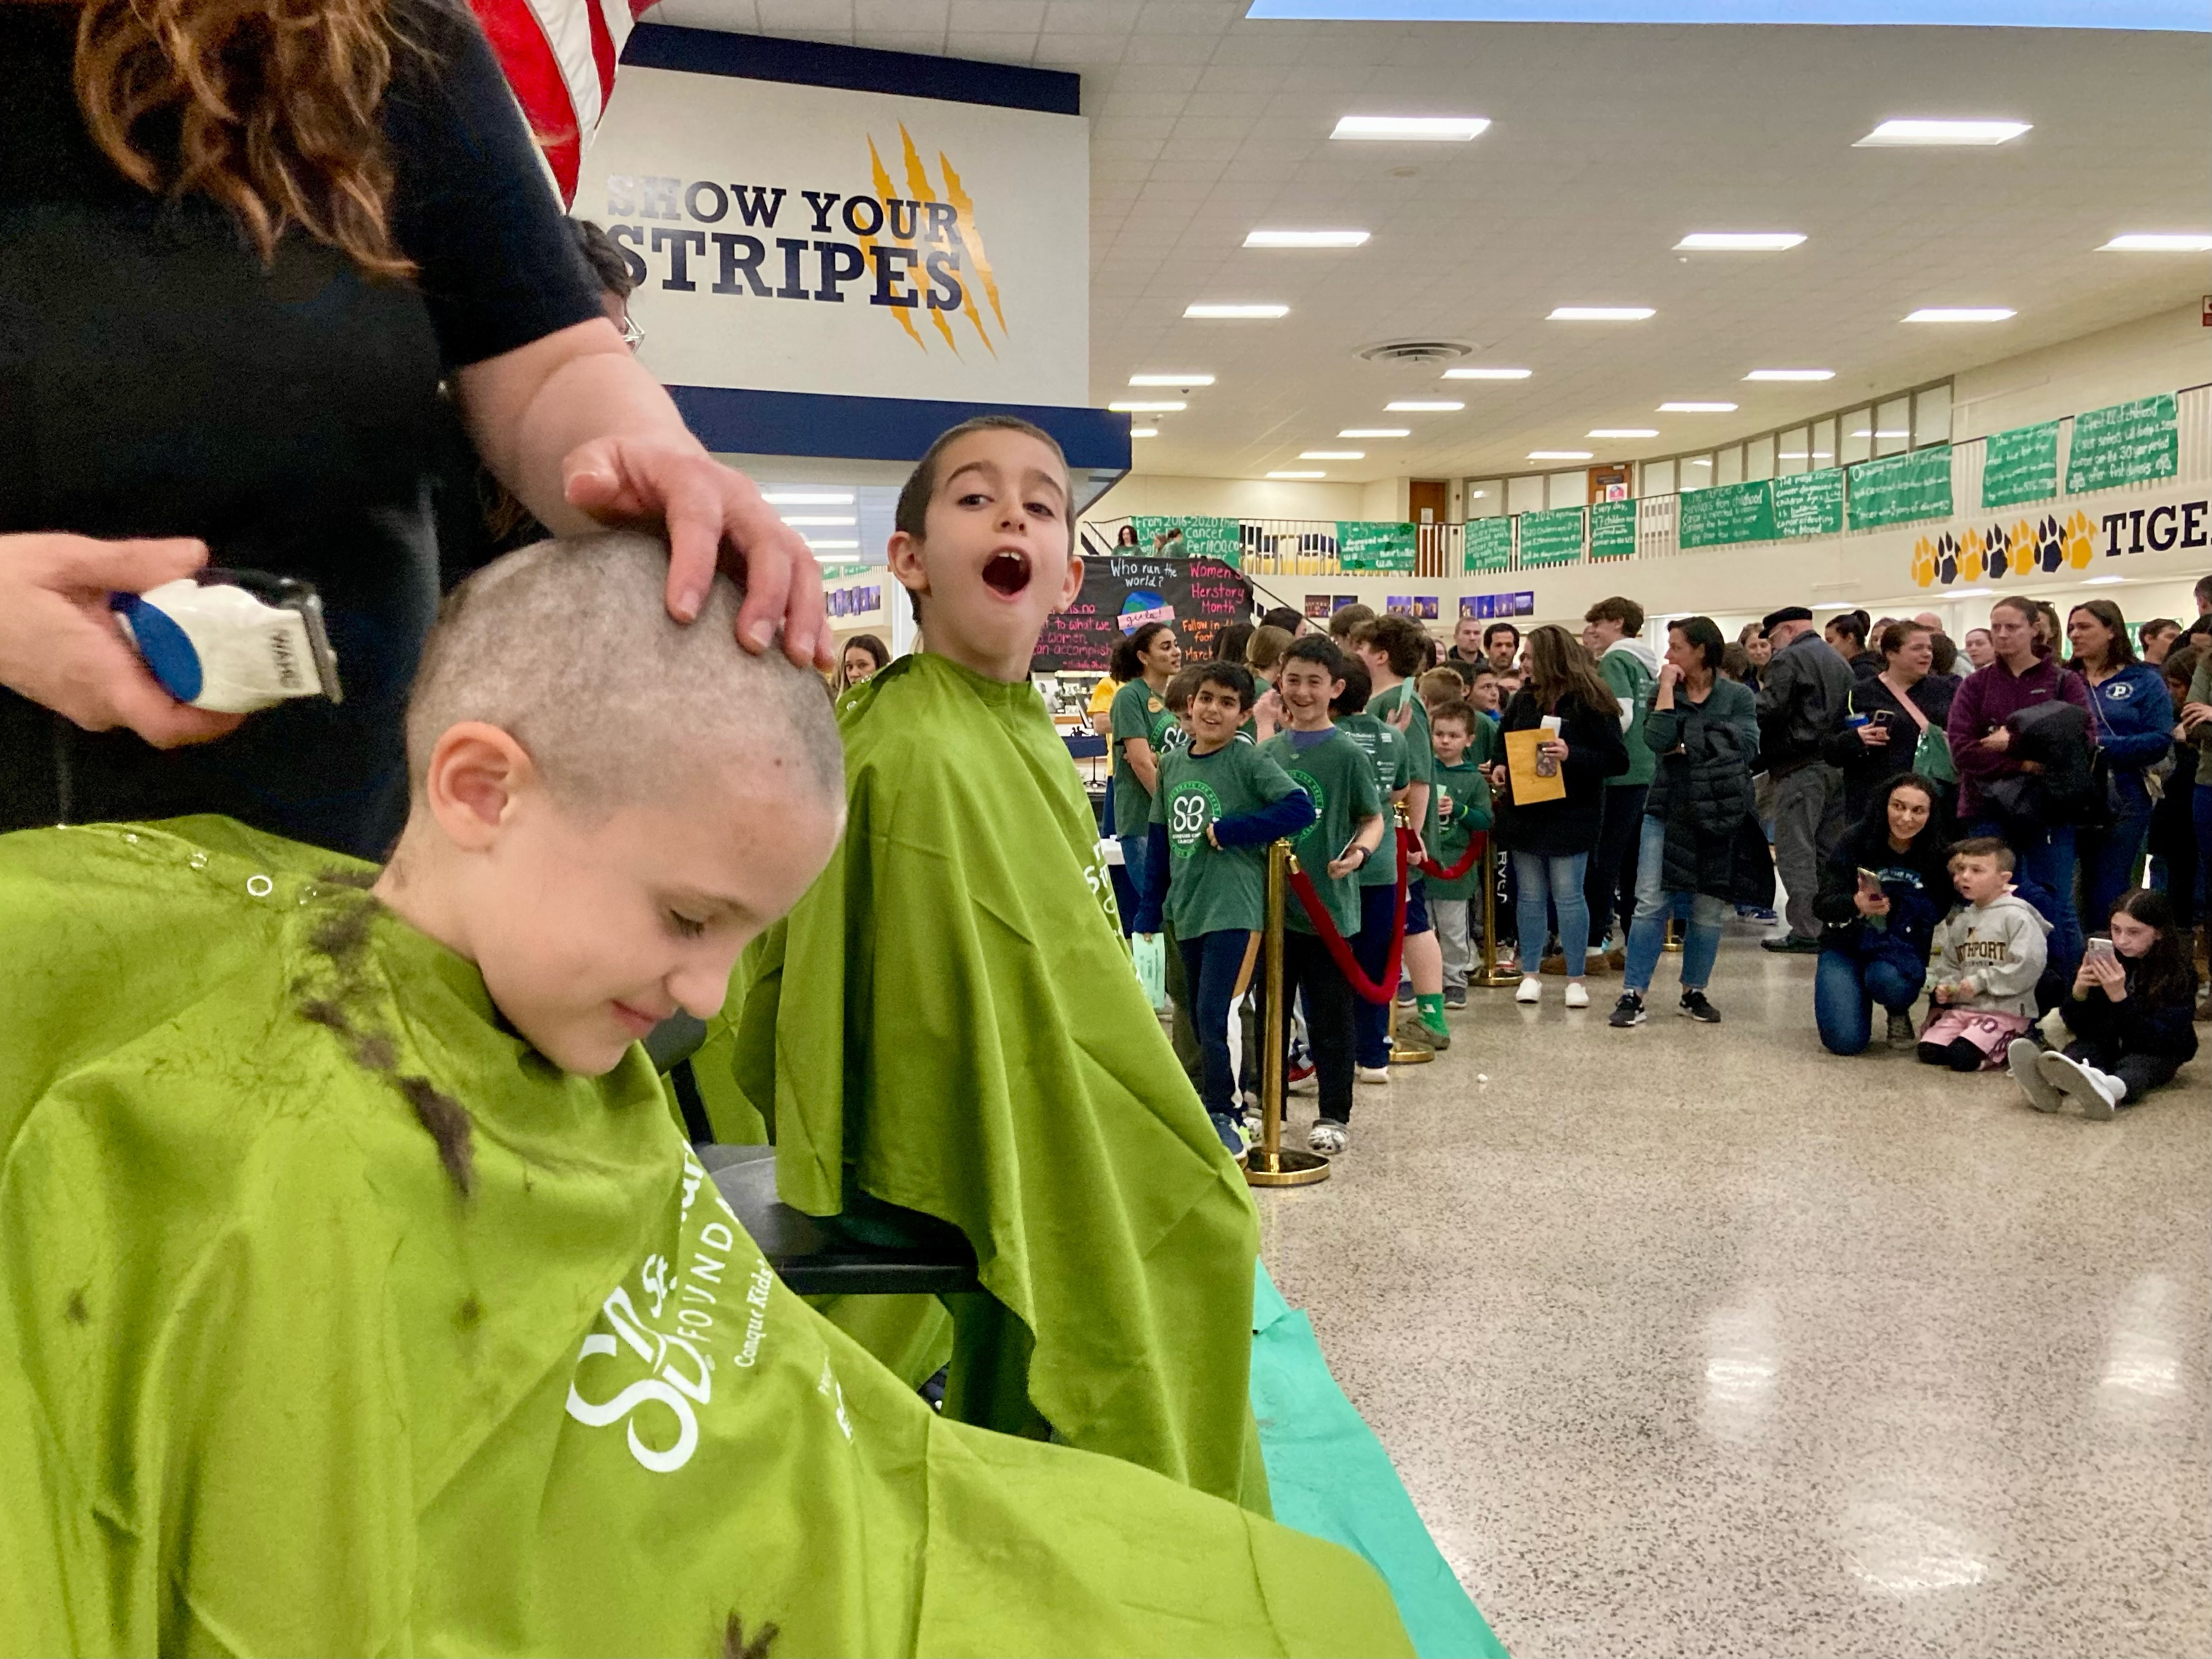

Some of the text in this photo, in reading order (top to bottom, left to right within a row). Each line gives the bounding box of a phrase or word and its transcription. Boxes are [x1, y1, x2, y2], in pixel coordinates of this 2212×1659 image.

[608, 174, 963, 245] SHOW YOUR
[606, 224, 963, 311] STRIPES
[2119, 445, 2132, 460] 30
[1776, 488, 1799, 498] cancer
[1592, 503, 1612, 515] Every
[1776, 497, 1804, 508] children
[1135, 516, 1162, 528] From
[1164, 515, 1219, 528] 2016-2020
[1521, 513, 1532, 526] In
[1535, 510, 1556, 523] 2024
[1592, 515, 1604, 528] 47
[1604, 514, 1626, 526] children
[1777, 518, 1799, 529] cancer
[1185, 527, 1224, 539] Cancer
[1798, 523, 1823, 535] blood
[2101, 500, 2212, 557] TIGE
[1187, 540, 1207, 553] Per
[1110, 558, 1177, 578] Who run the
[1189, 561, 1243, 580] Womens
[1125, 575, 1164, 587] world?
[1191, 582, 1245, 604] Herstory
[1069, 604, 1079, 614] is
[1081, 604, 1095, 614] no
[1201, 600, 1236, 614] Month
[1054, 617, 1065, 630] to
[1069, 617, 1092, 630] what
[1182, 619, 1207, 633] Follow
[1210, 620, 1220, 630] in
[1194, 631, 1215, 643] foot
[1034, 641, 1113, 657] can accomplish
[2112, 685, 2127, 697] P
[676, 1221, 735, 1343] FOUND
